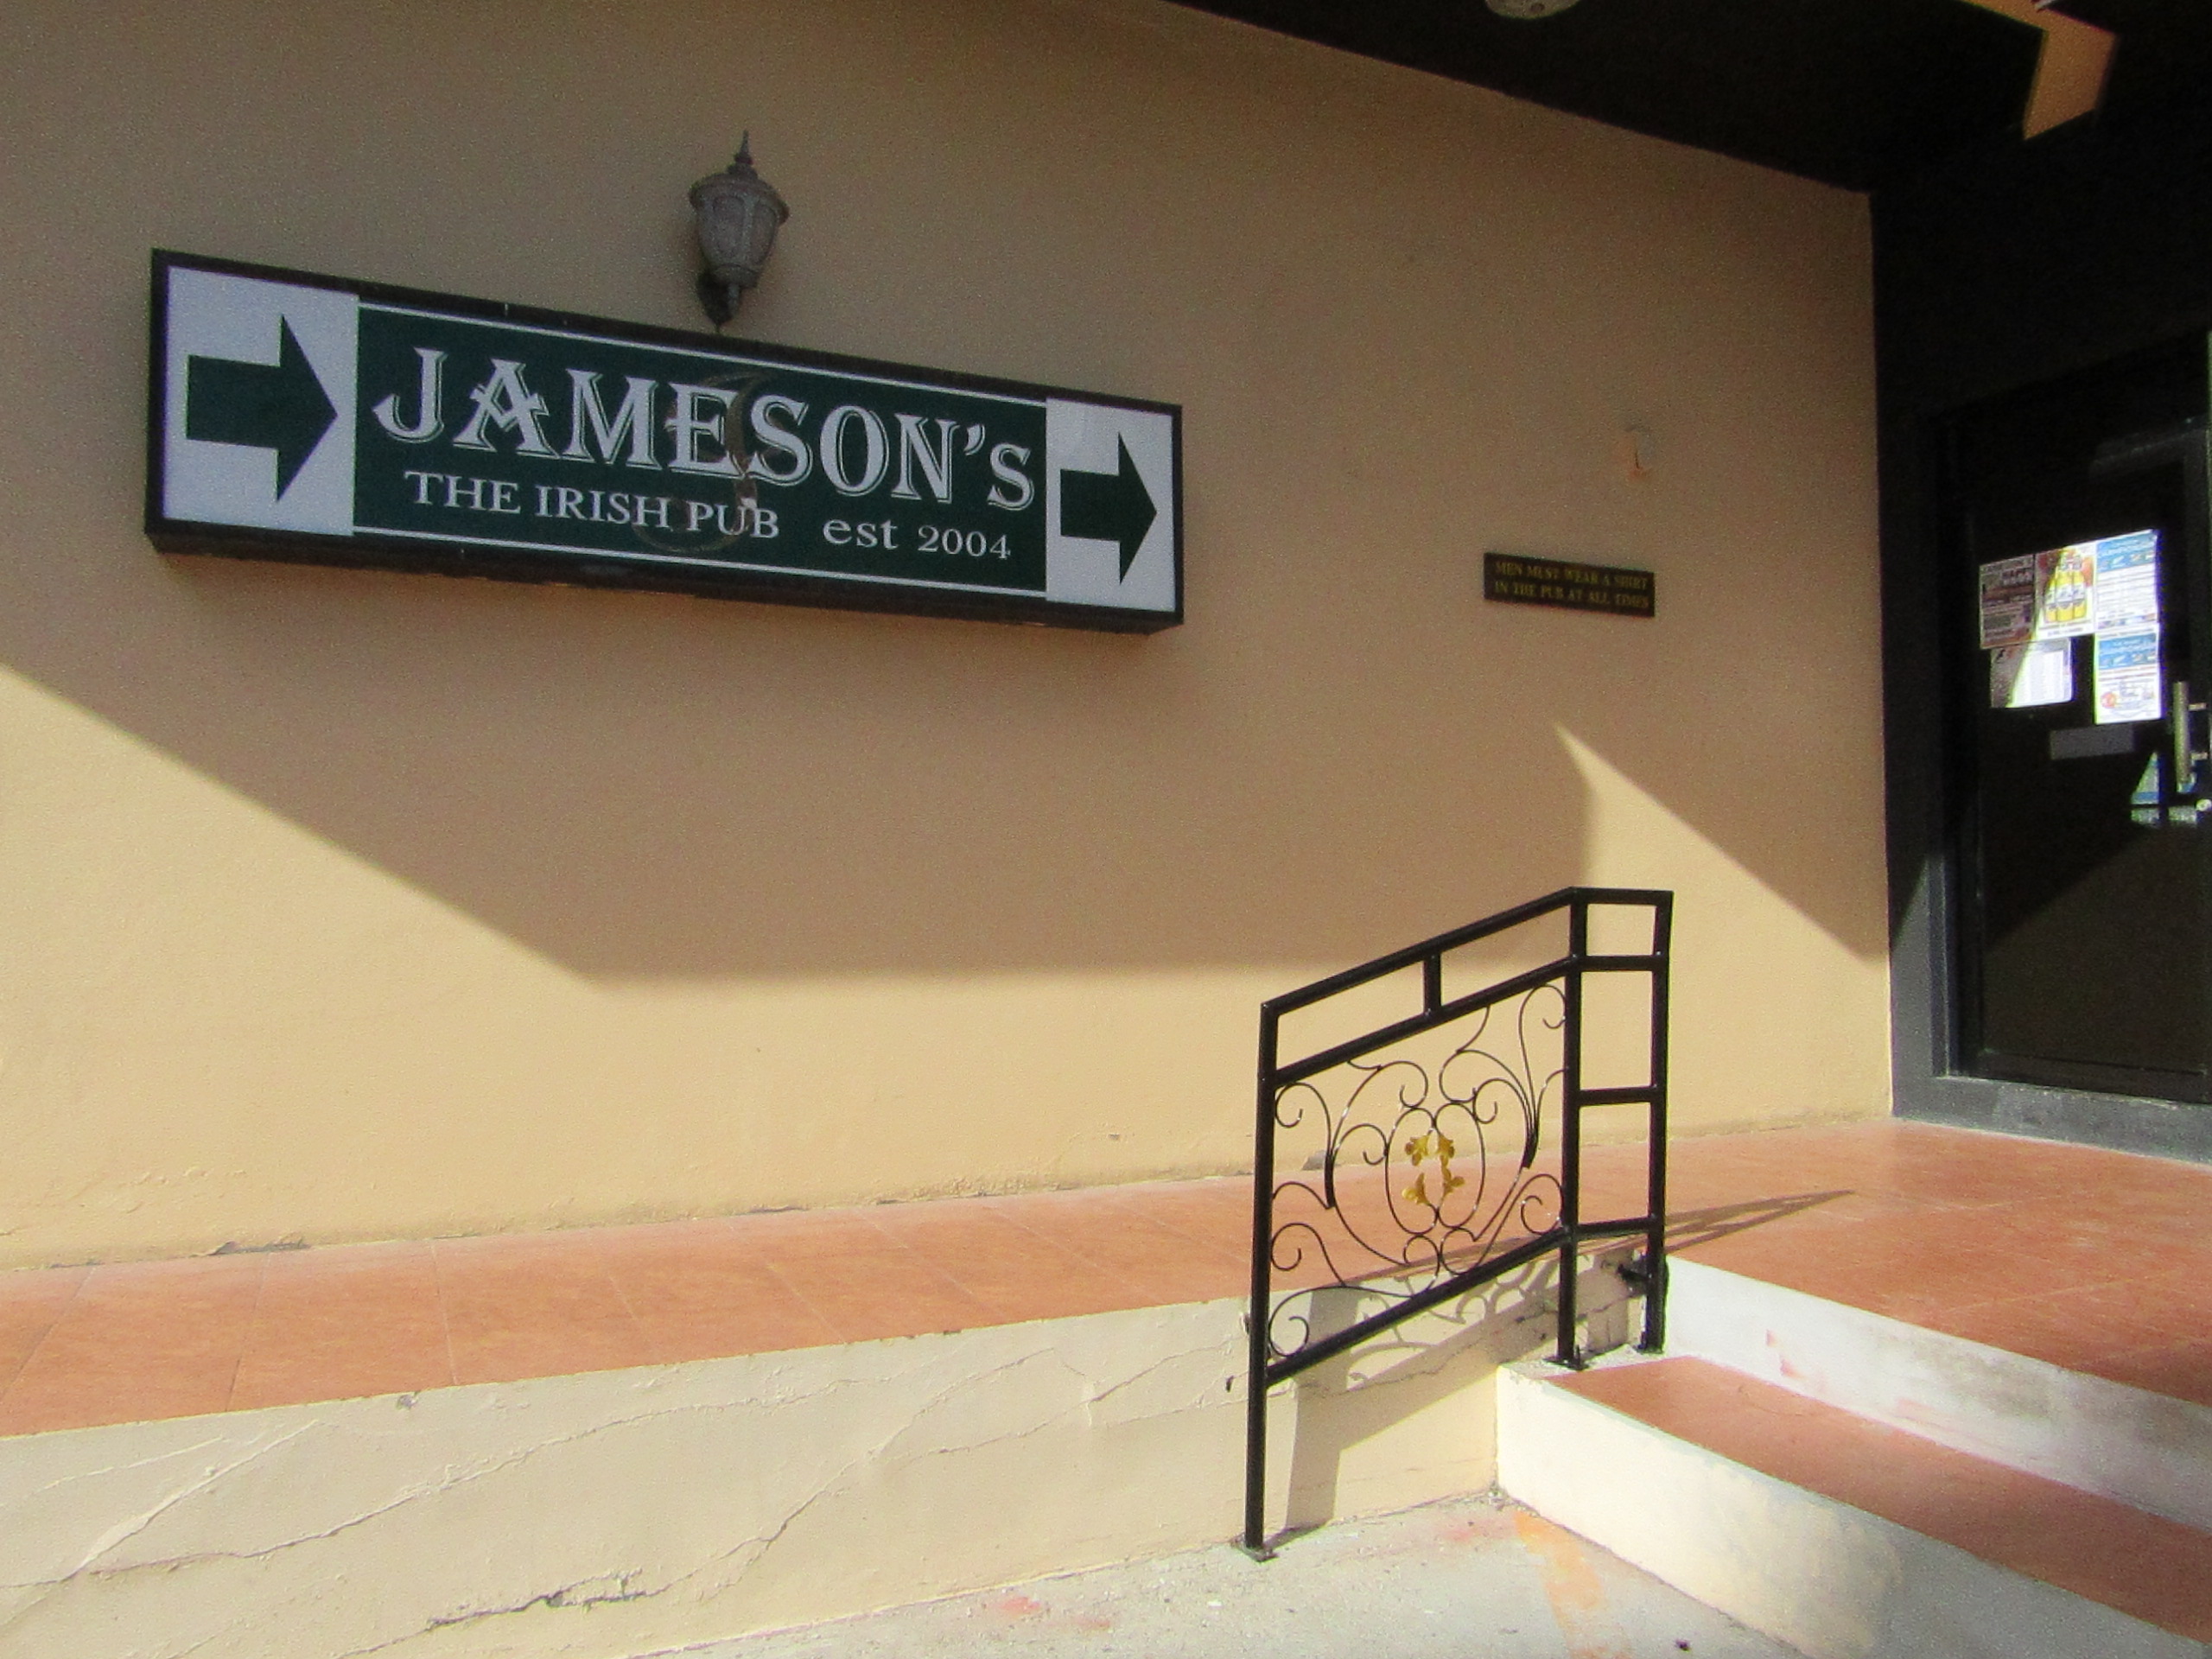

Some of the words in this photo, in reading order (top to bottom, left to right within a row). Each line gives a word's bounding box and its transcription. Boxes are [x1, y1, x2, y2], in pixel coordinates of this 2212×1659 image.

[372, 346, 1034, 510] JAMESON's
[404, 470, 520, 514] THE
[535, 486, 670, 529] IRISH
[689, 502, 779, 539] PUB
[823, 518, 899, 550] est
[918, 524, 1012, 560] 2004
